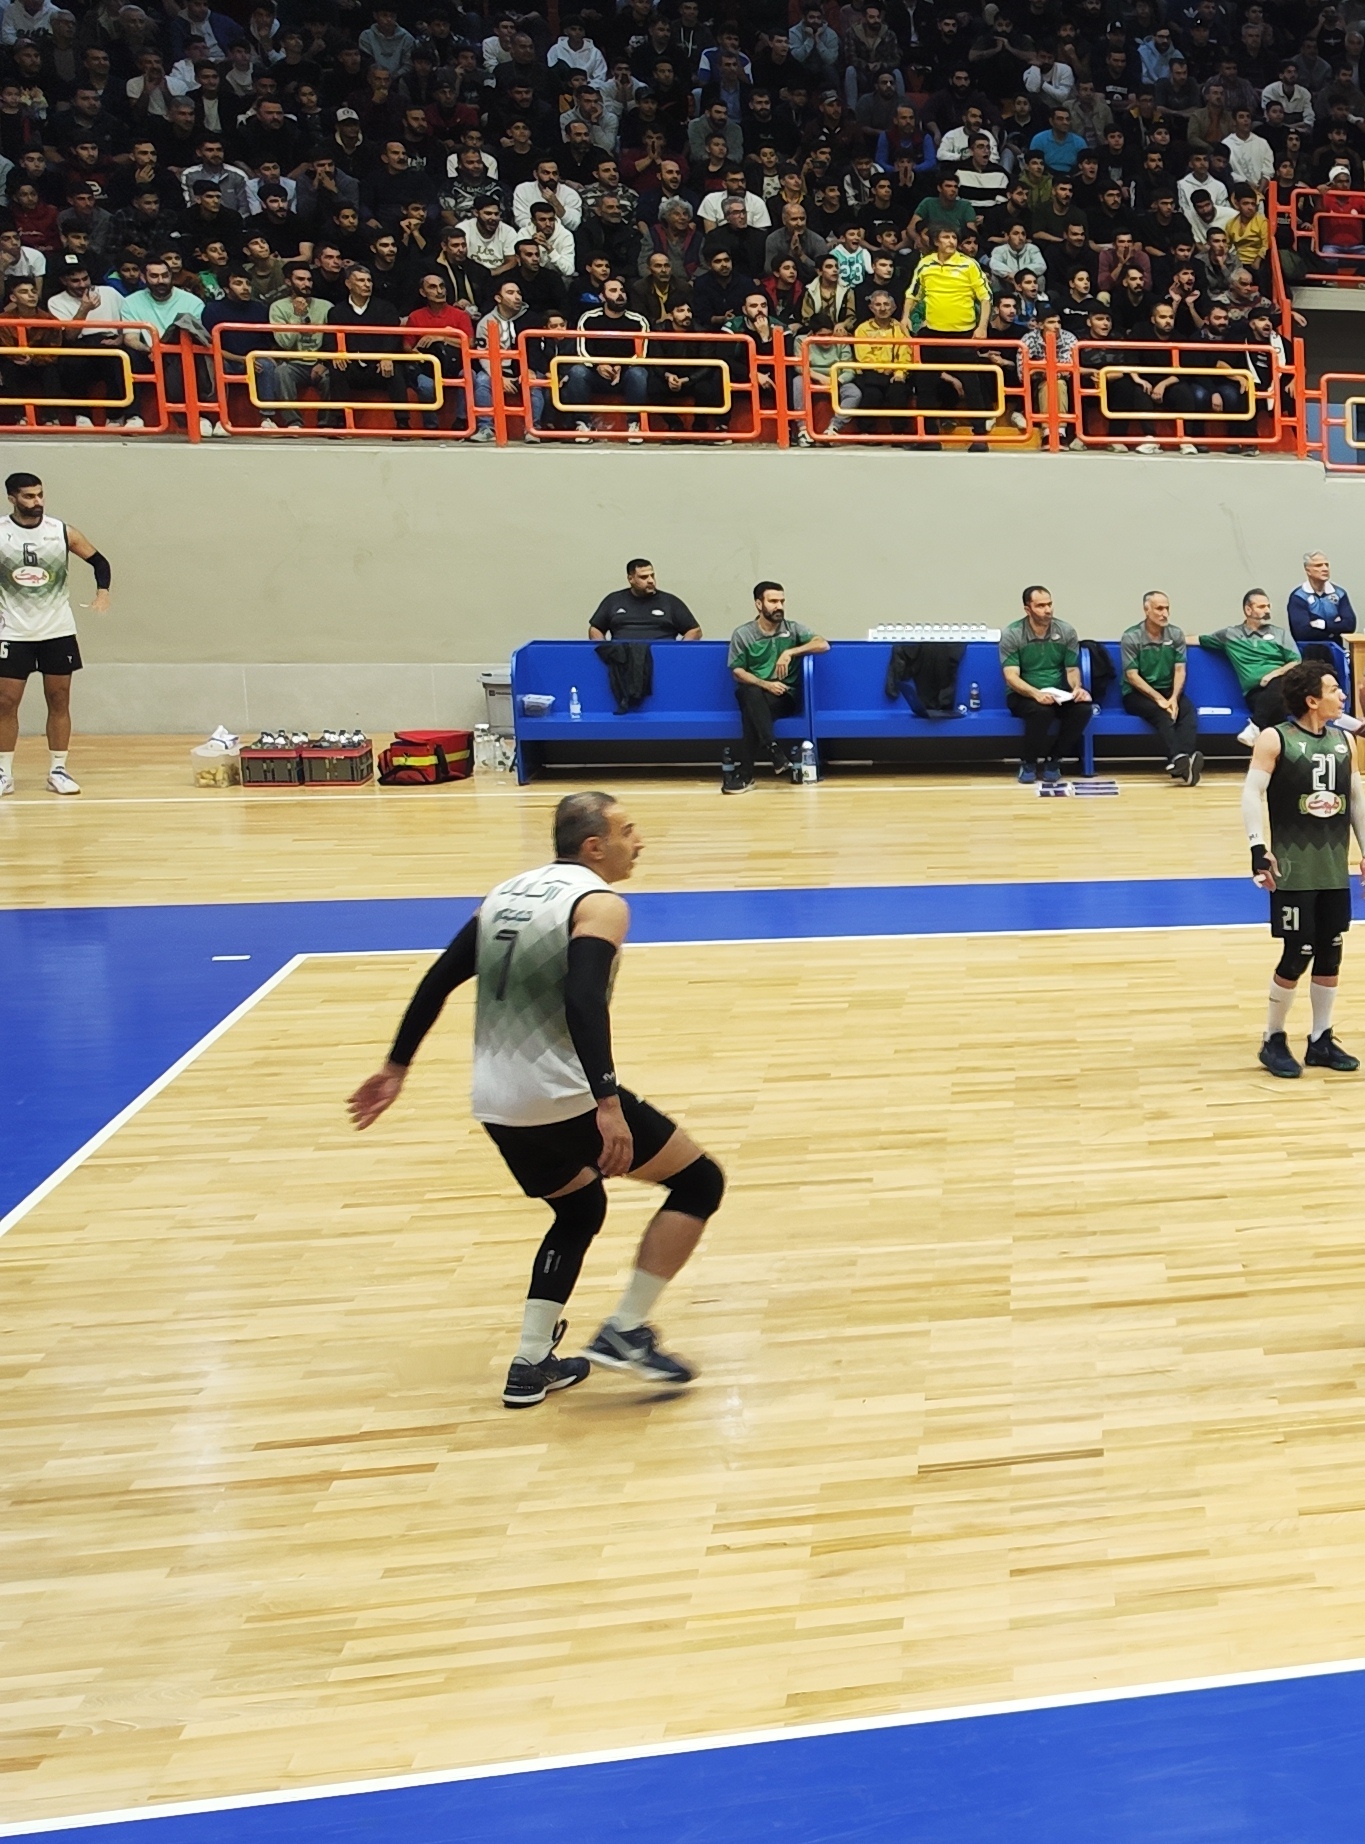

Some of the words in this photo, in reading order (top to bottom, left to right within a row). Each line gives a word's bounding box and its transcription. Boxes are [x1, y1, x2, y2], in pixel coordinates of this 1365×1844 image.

[23, 542, 38, 566] 6
[1311, 753, 1336, 791] 21
[1281, 905, 1300, 931] 21
[494, 928, 520, 1001] 7
